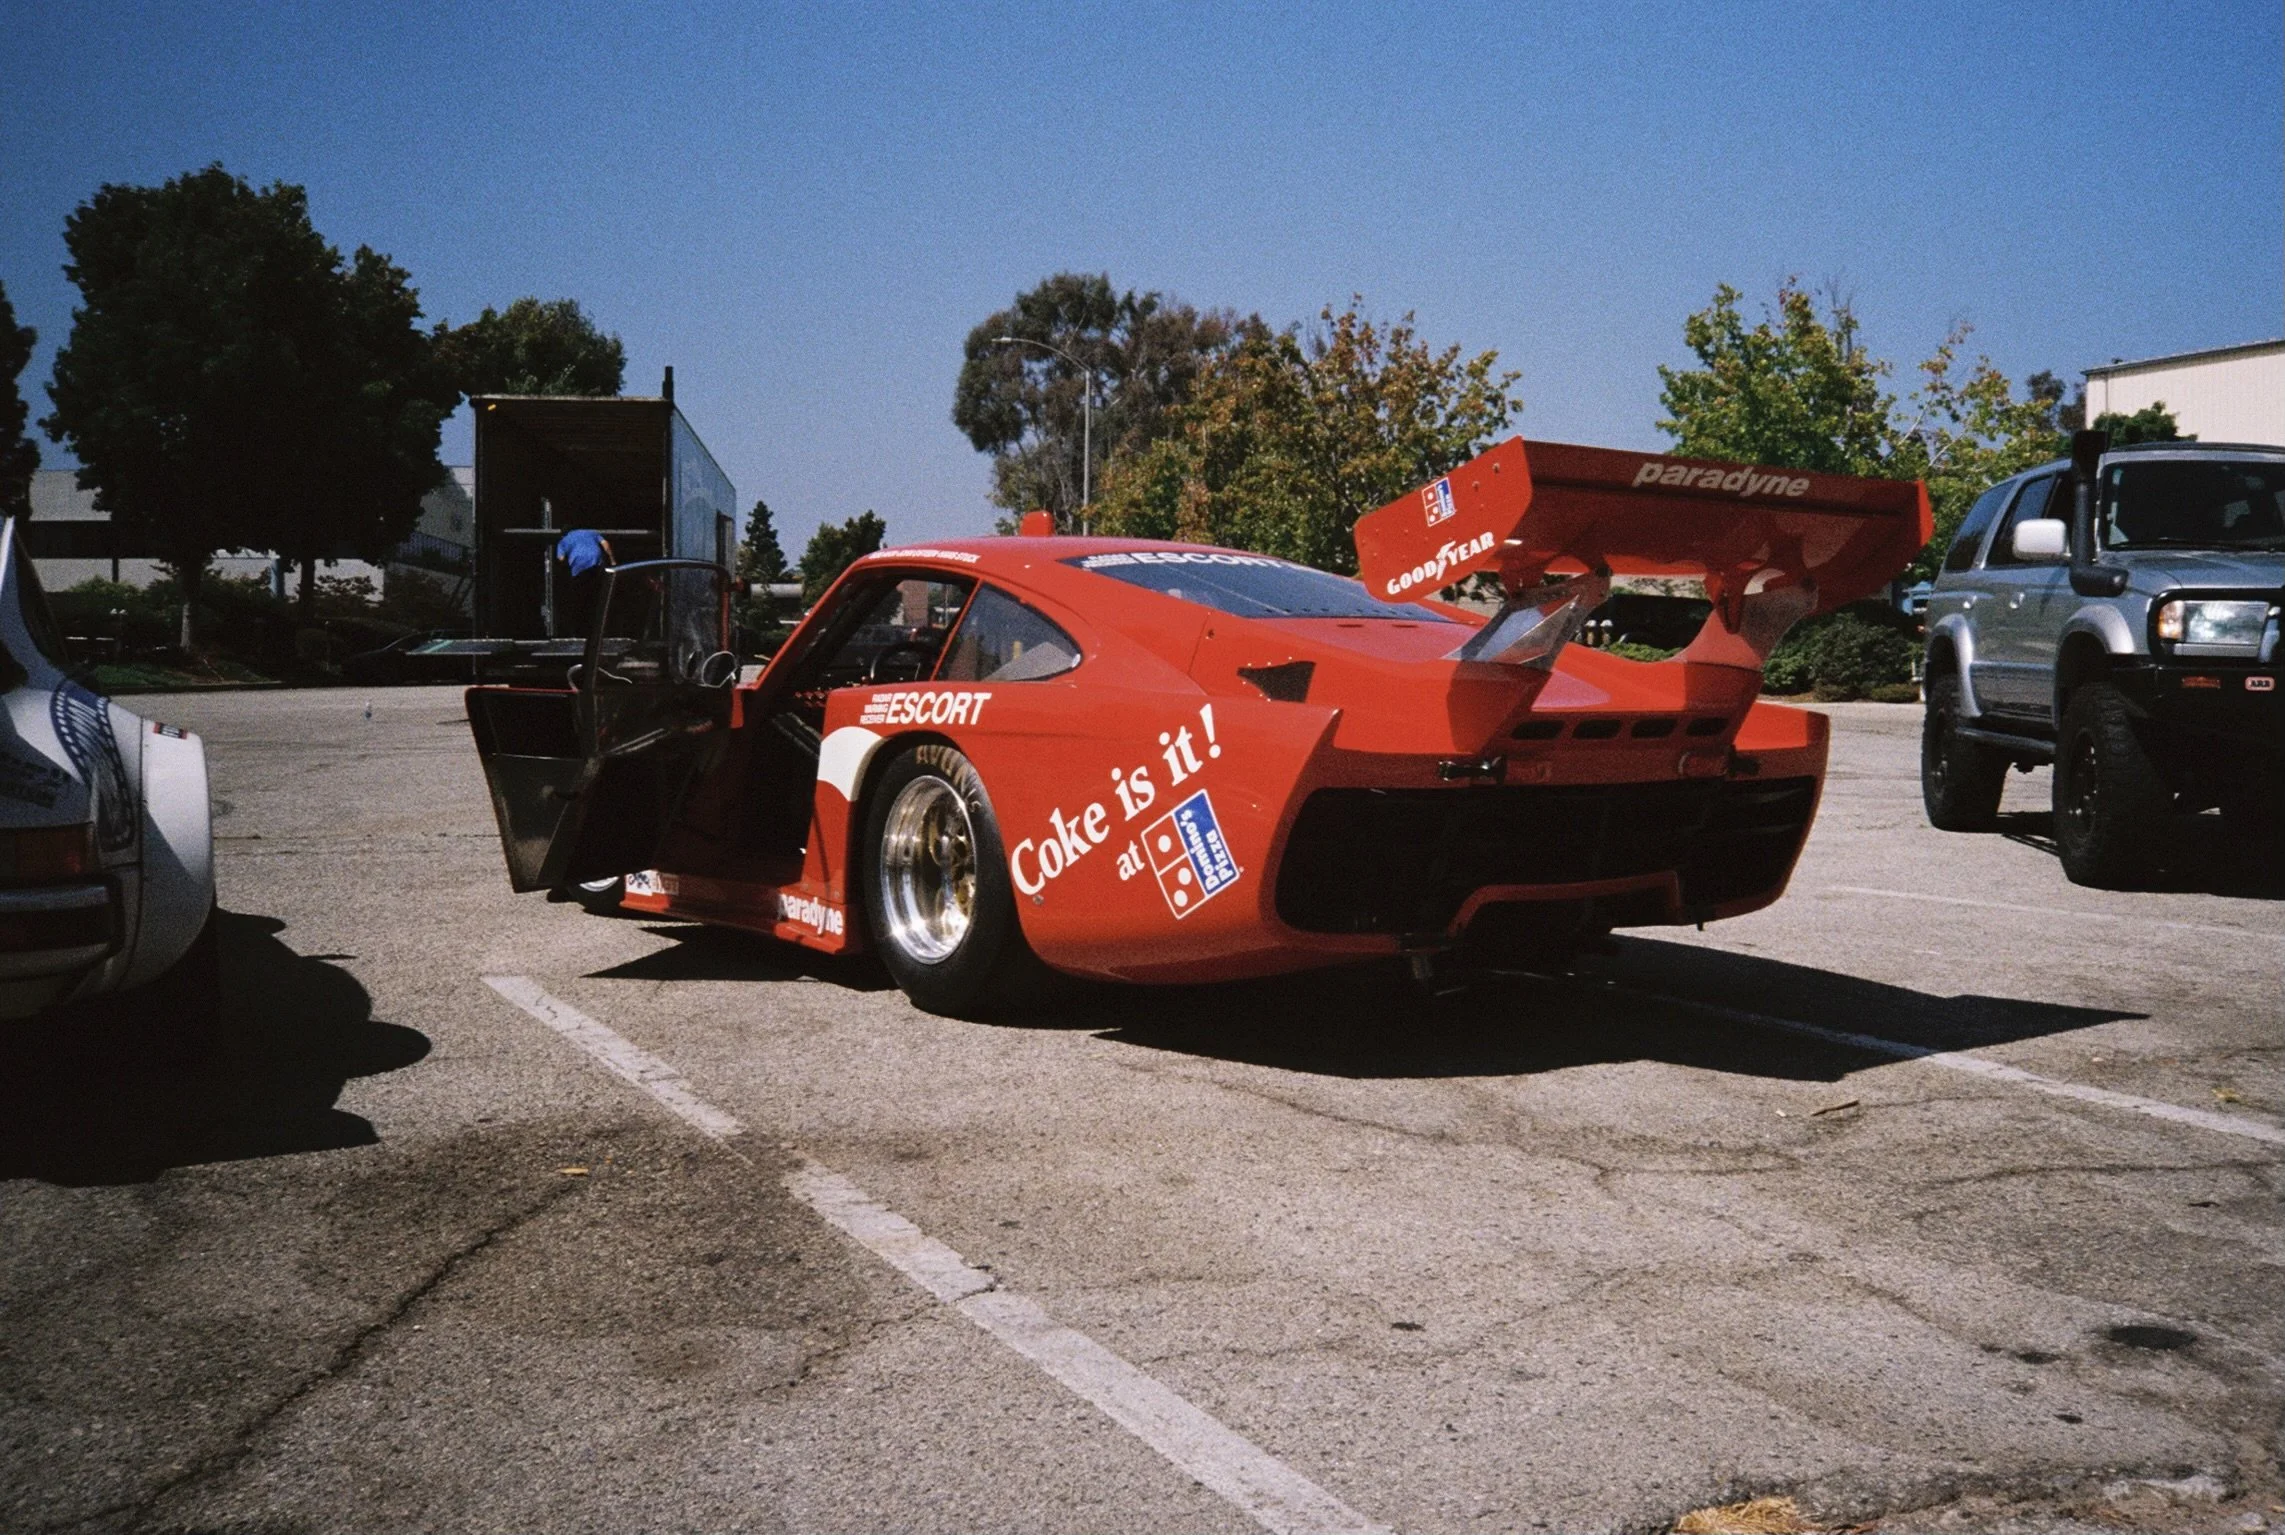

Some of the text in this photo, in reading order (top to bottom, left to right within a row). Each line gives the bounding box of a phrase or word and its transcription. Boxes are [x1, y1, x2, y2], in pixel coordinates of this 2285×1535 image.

[1631, 462, 1810, 497] paradyne
[1131, 552, 1284, 568] ESCORT
[1387, 531, 1495, 595] GOODYEAR
[886, 691, 992, 725] ESCORT
[1011, 807, 1110, 895] Coke
[1111, 767, 1156, 821] is
[1180, 809, 1221, 891] Domino's
[1116, 840, 1146, 881] at
[1206, 829, 1234, 882] Pizza
